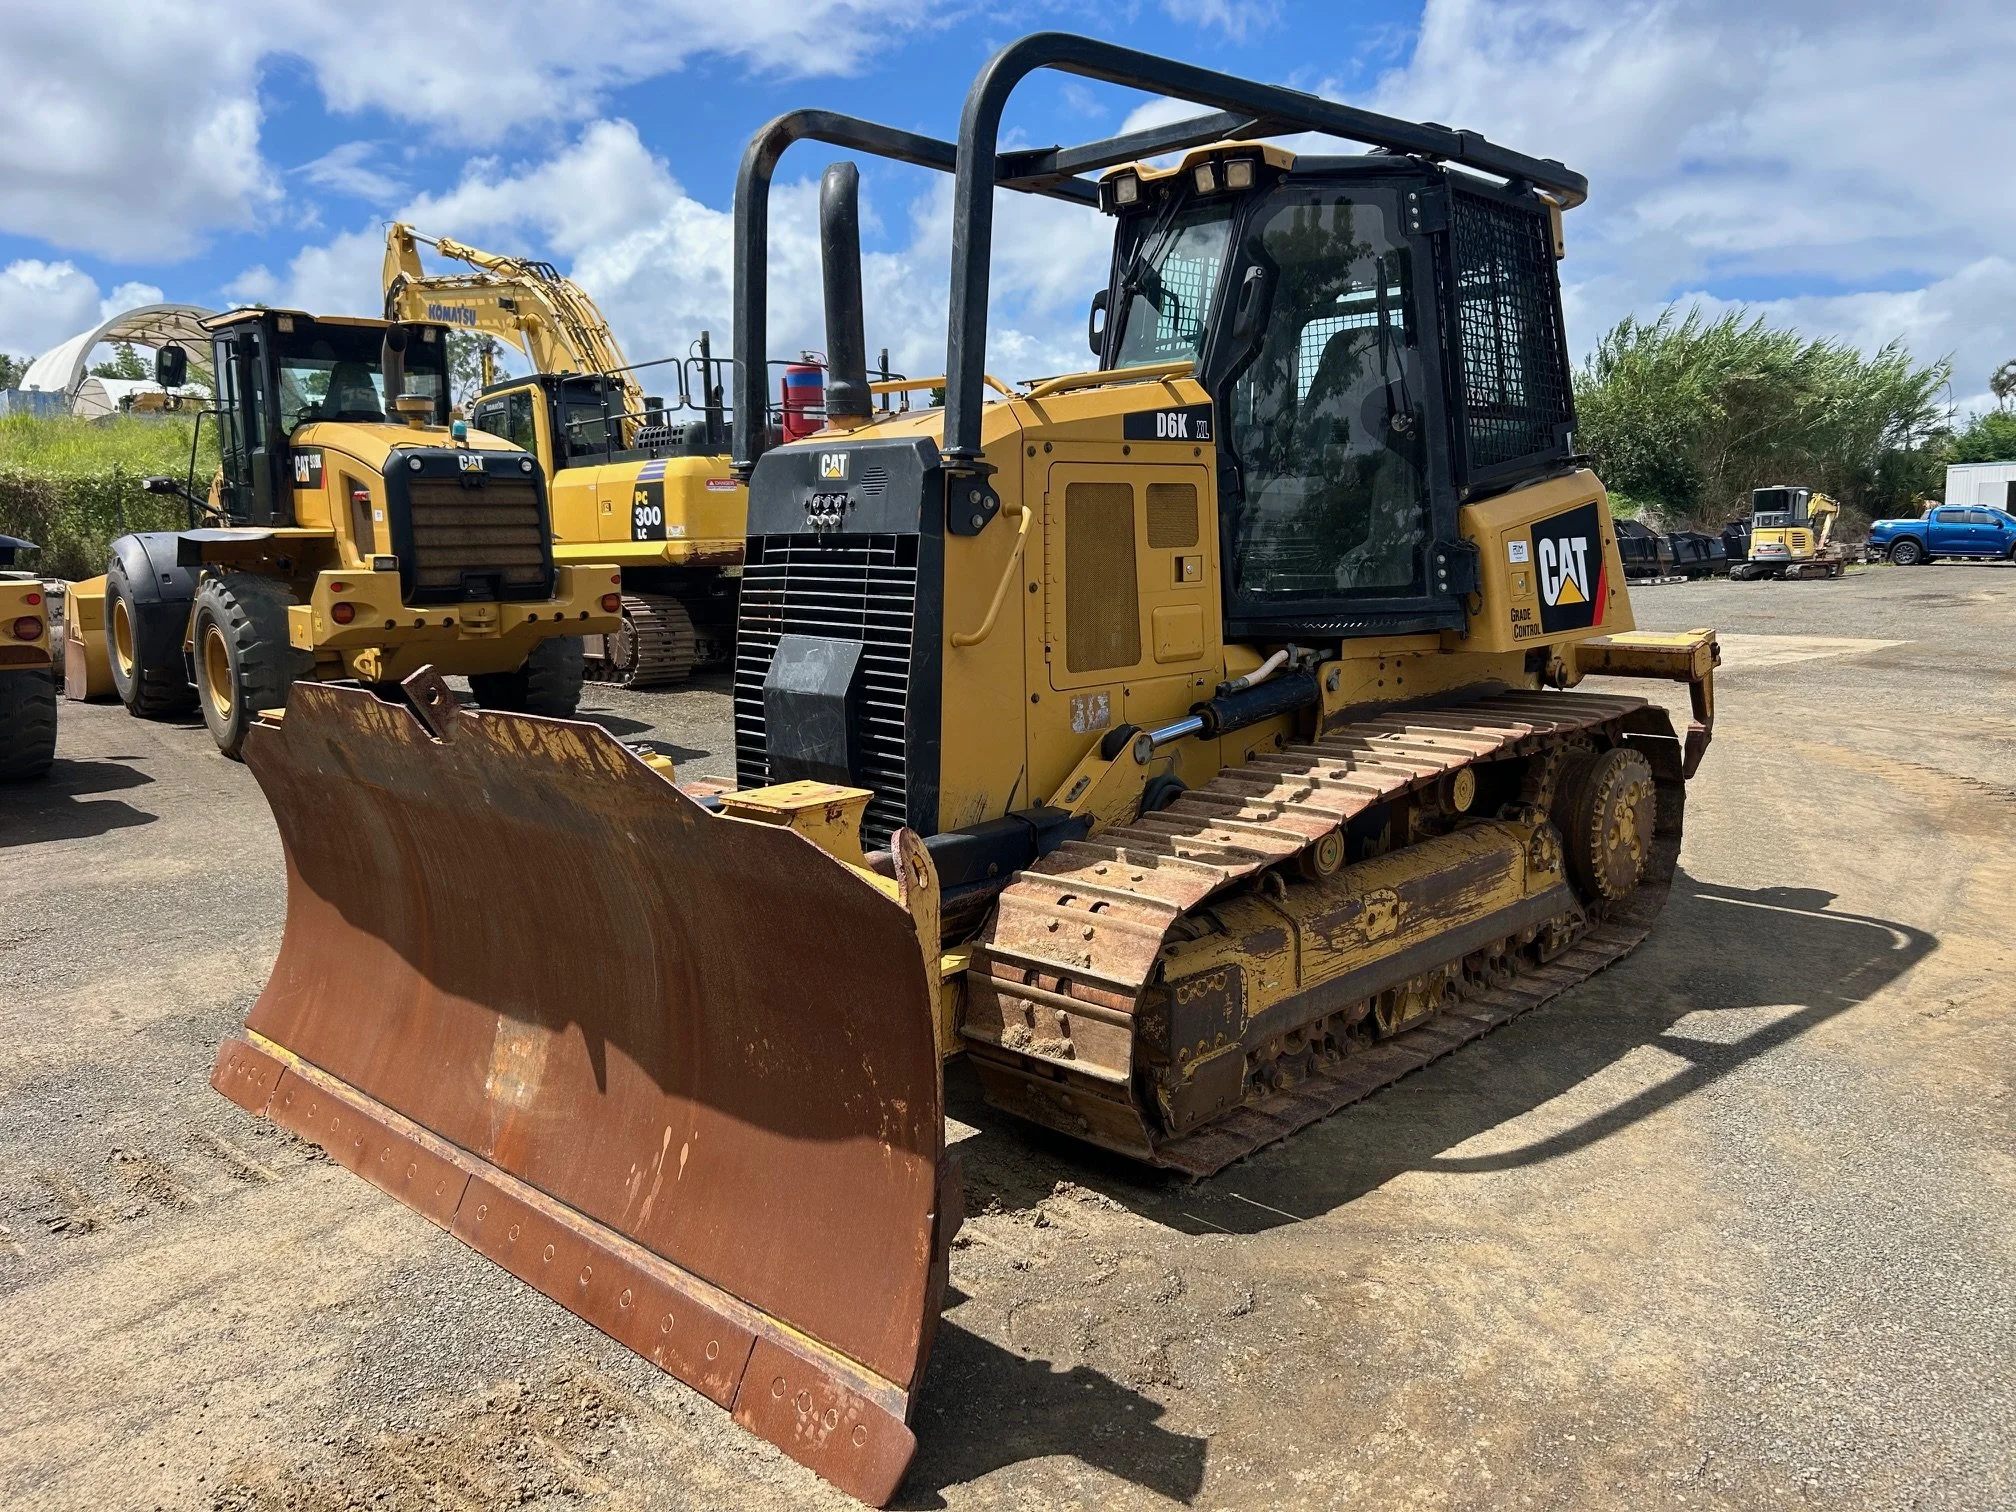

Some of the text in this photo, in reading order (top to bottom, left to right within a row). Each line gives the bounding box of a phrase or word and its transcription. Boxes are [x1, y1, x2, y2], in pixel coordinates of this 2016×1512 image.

[429, 303, 476, 326] KOMATSU
[1157, 412, 1210, 439] D6K XL
[295, 455, 310, 482] CAT
[459, 455, 484, 471] CAT
[821, 453, 847, 478] CAT
[635, 490, 648, 505] PC
[635, 506, 661, 526] 300
[637, 528, 647, 539] LC
[1538, 537, 1590, 606] CAT
[1513, 624, 1541, 638] CONTROL
